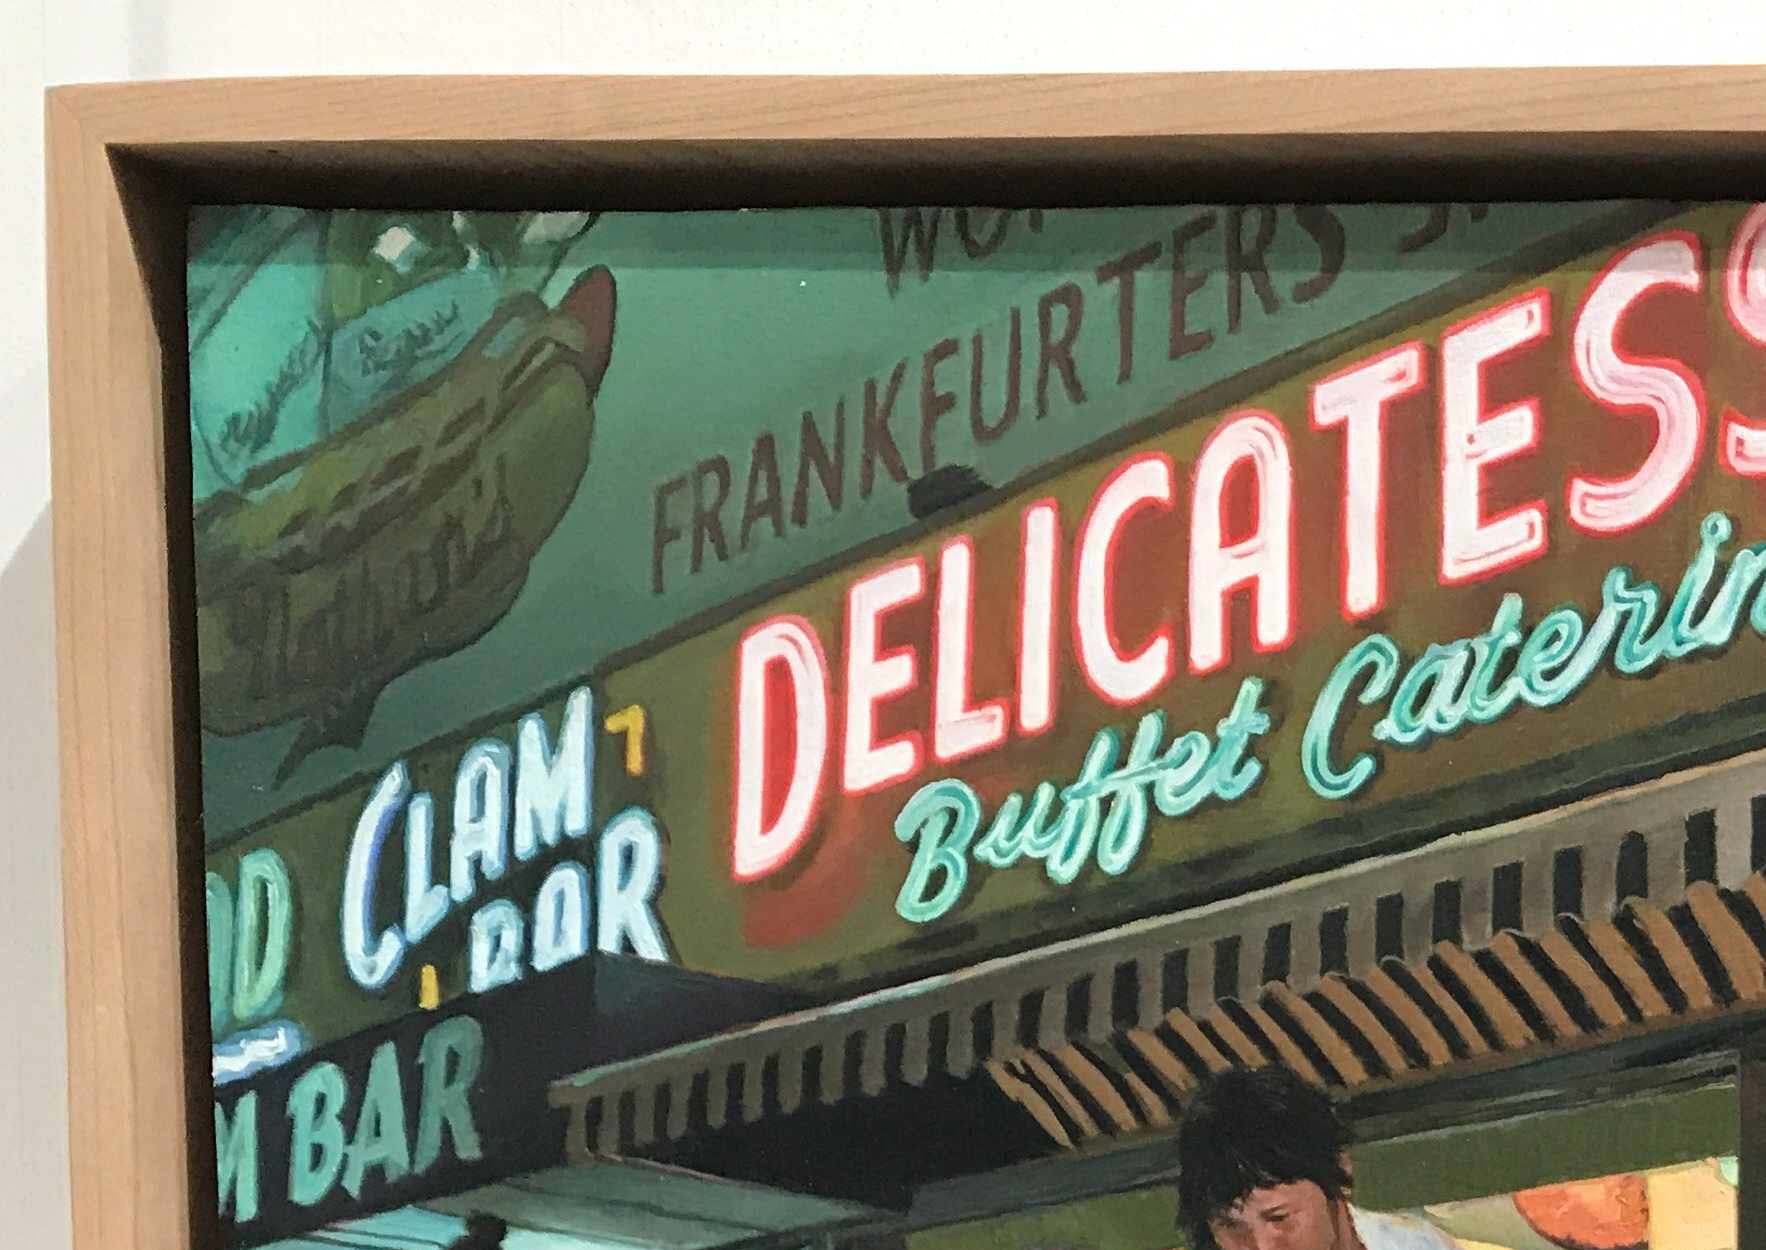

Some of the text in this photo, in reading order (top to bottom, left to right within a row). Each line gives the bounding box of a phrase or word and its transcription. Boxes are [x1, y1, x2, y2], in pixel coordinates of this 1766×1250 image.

[650, 204, 1346, 594] FRANKFURTERS
[340, 686, 594, 990] CLAM
[894, 676, 1268, 922] Buffet
[288, 1014, 483, 1205] BAR
